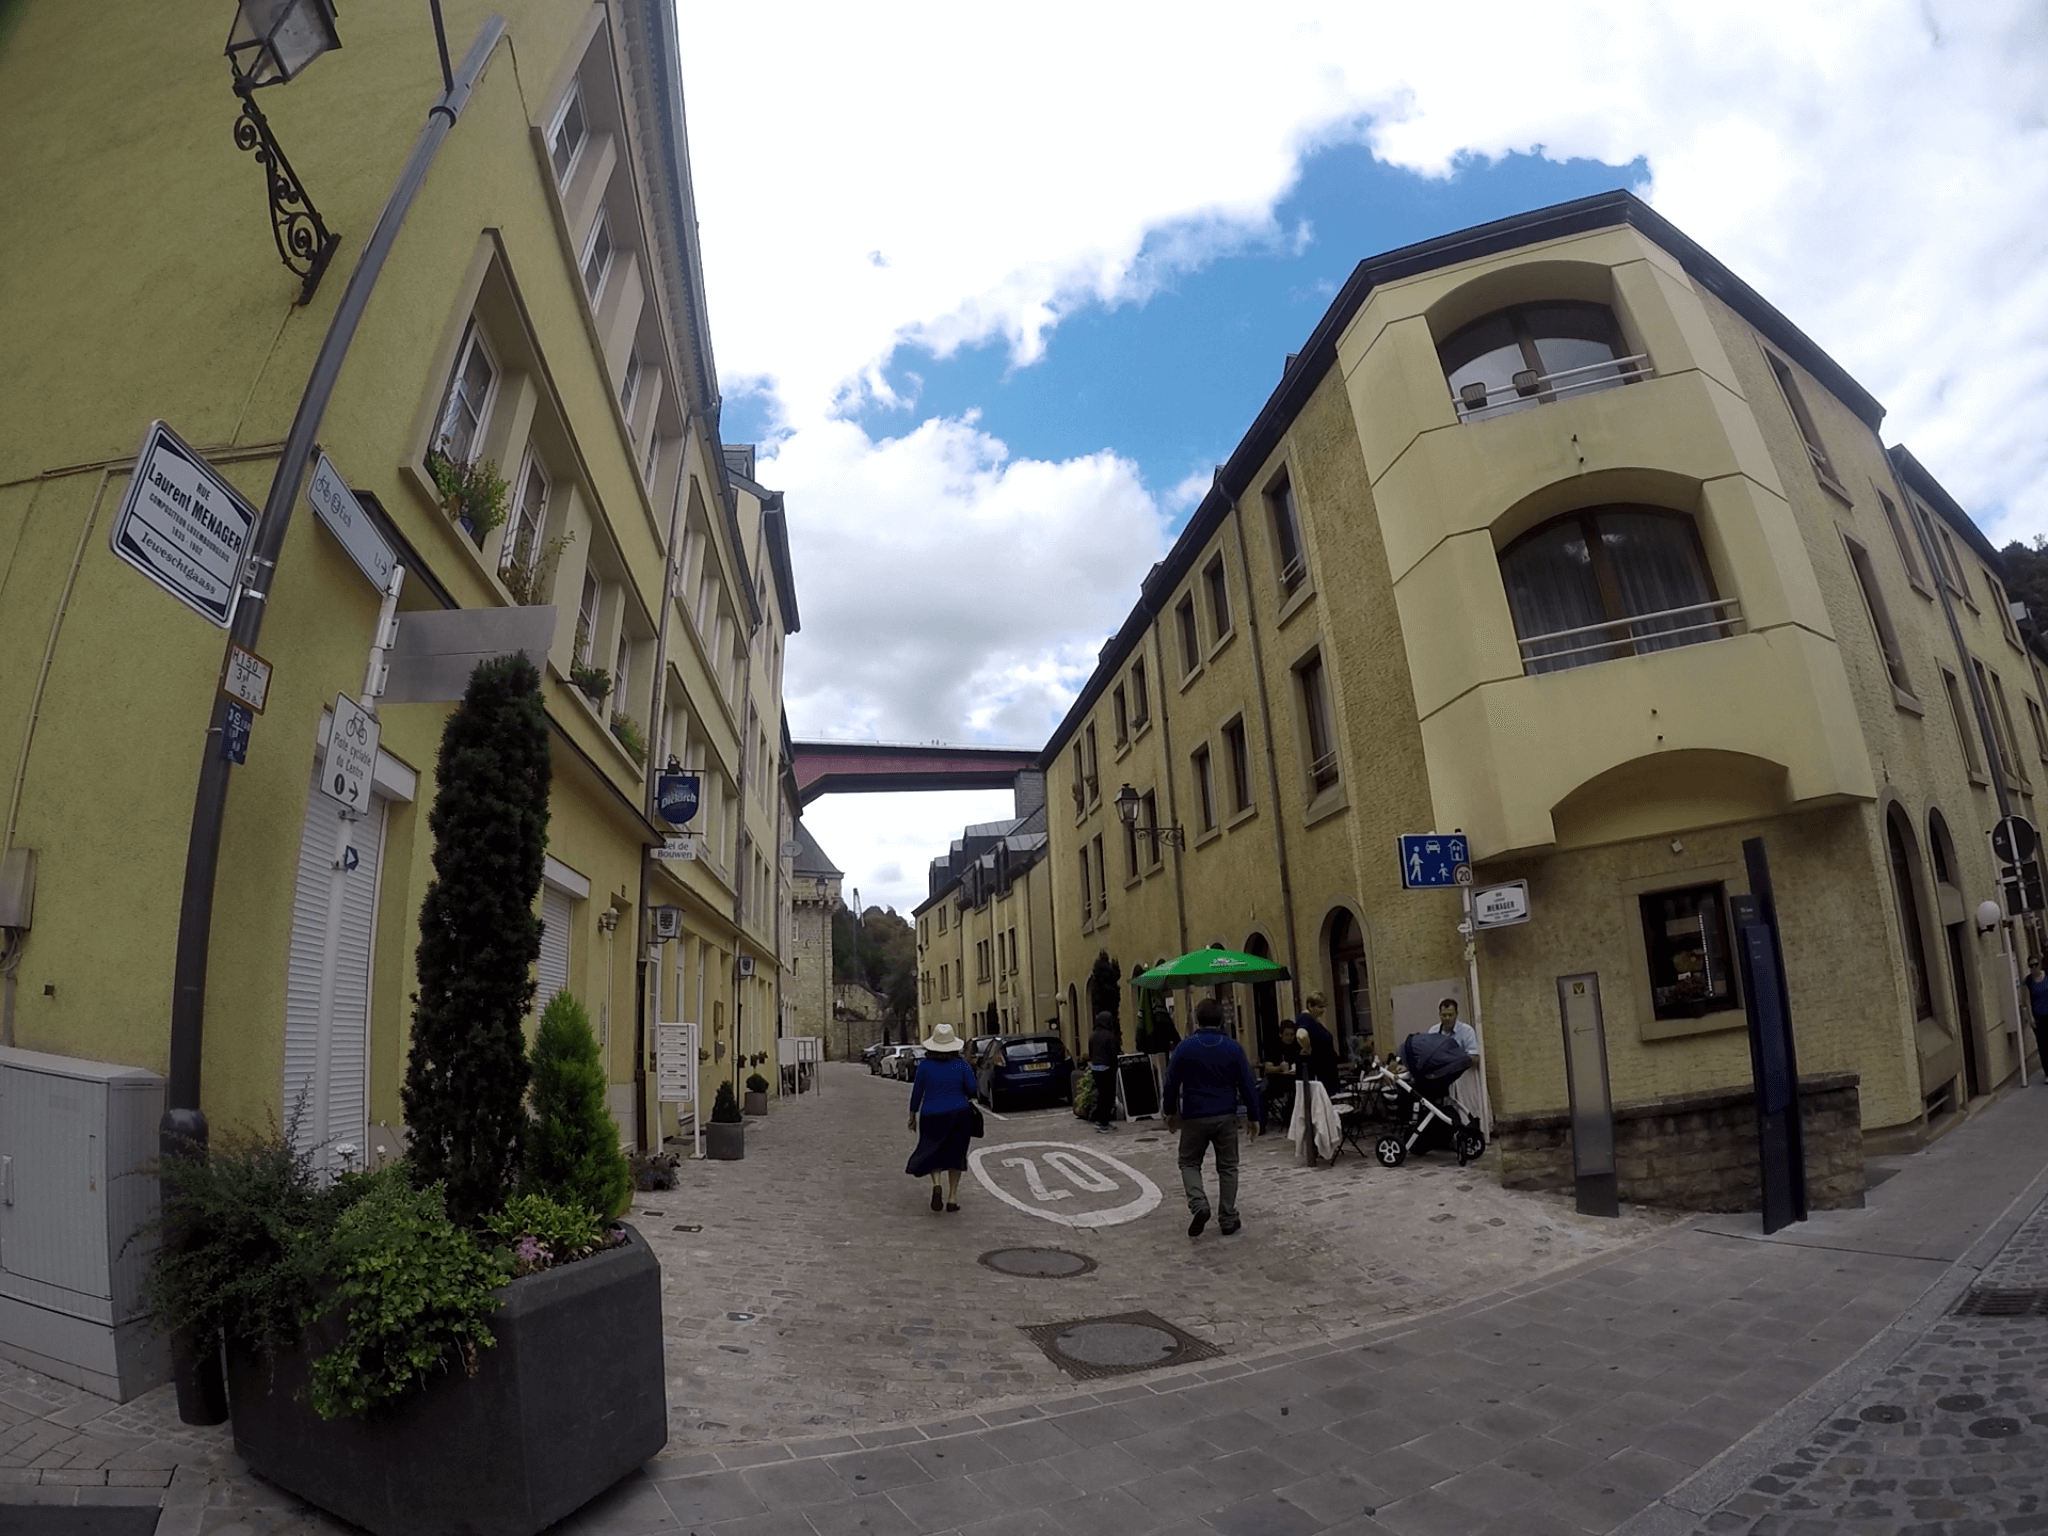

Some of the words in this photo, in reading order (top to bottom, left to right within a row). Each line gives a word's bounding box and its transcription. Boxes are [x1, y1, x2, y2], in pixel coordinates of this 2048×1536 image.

[195, 482, 211, 501] RUE
[148, 462, 193, 512] Laurent
[191, 499, 242, 554] MENAGER
[339, 504, 352, 528] Eich
[149, 492, 187, 529] COMPOSITEUR
[186, 523, 230, 562] LUXEMBOURGEOIS
[140, 531, 216, 594] Ieweschtgaass
[232, 648, 259, 673] H150
[334, 731, 349, 751] Piste
[350, 746, 371, 767] cyclable
[336, 754, 344, 768] du
[345, 758, 364, 780] Centre
[661, 792, 697, 809] Diekirch
[657, 849, 693, 859] Bouwen
[678, 841, 689, 850] de
[1459, 870, 1471, 882] 20
[1486, 901, 1515, 913] MENAGER
[1001, 1151, 1120, 1201] 20
